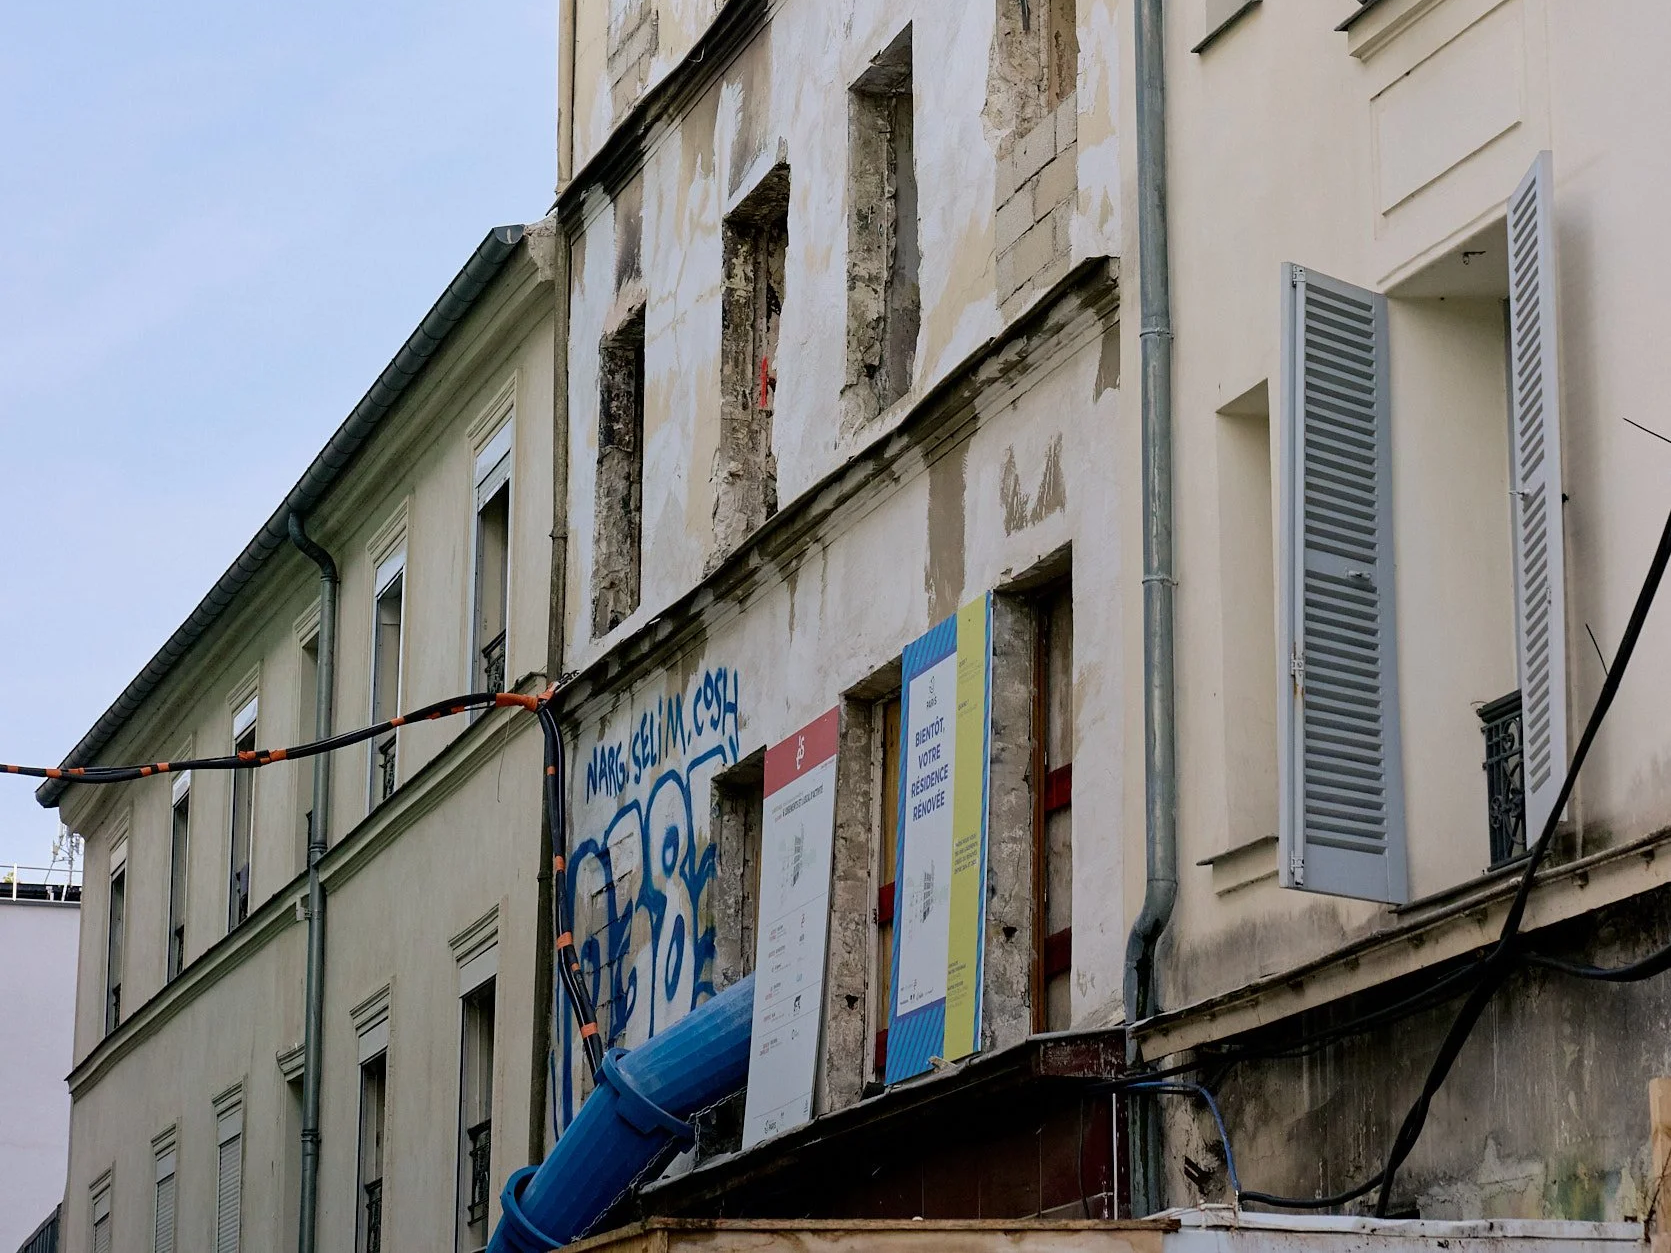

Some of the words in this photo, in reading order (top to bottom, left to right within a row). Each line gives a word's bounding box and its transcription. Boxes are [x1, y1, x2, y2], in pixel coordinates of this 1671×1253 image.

[926, 696, 937, 709] PARIS
[915, 715, 945, 747] BIENTÔT,
[918, 743, 941, 769] VOTRE
[911, 764, 949, 798] RÉSIDENCE
[913, 789, 945, 822] RÉNOVÉE
